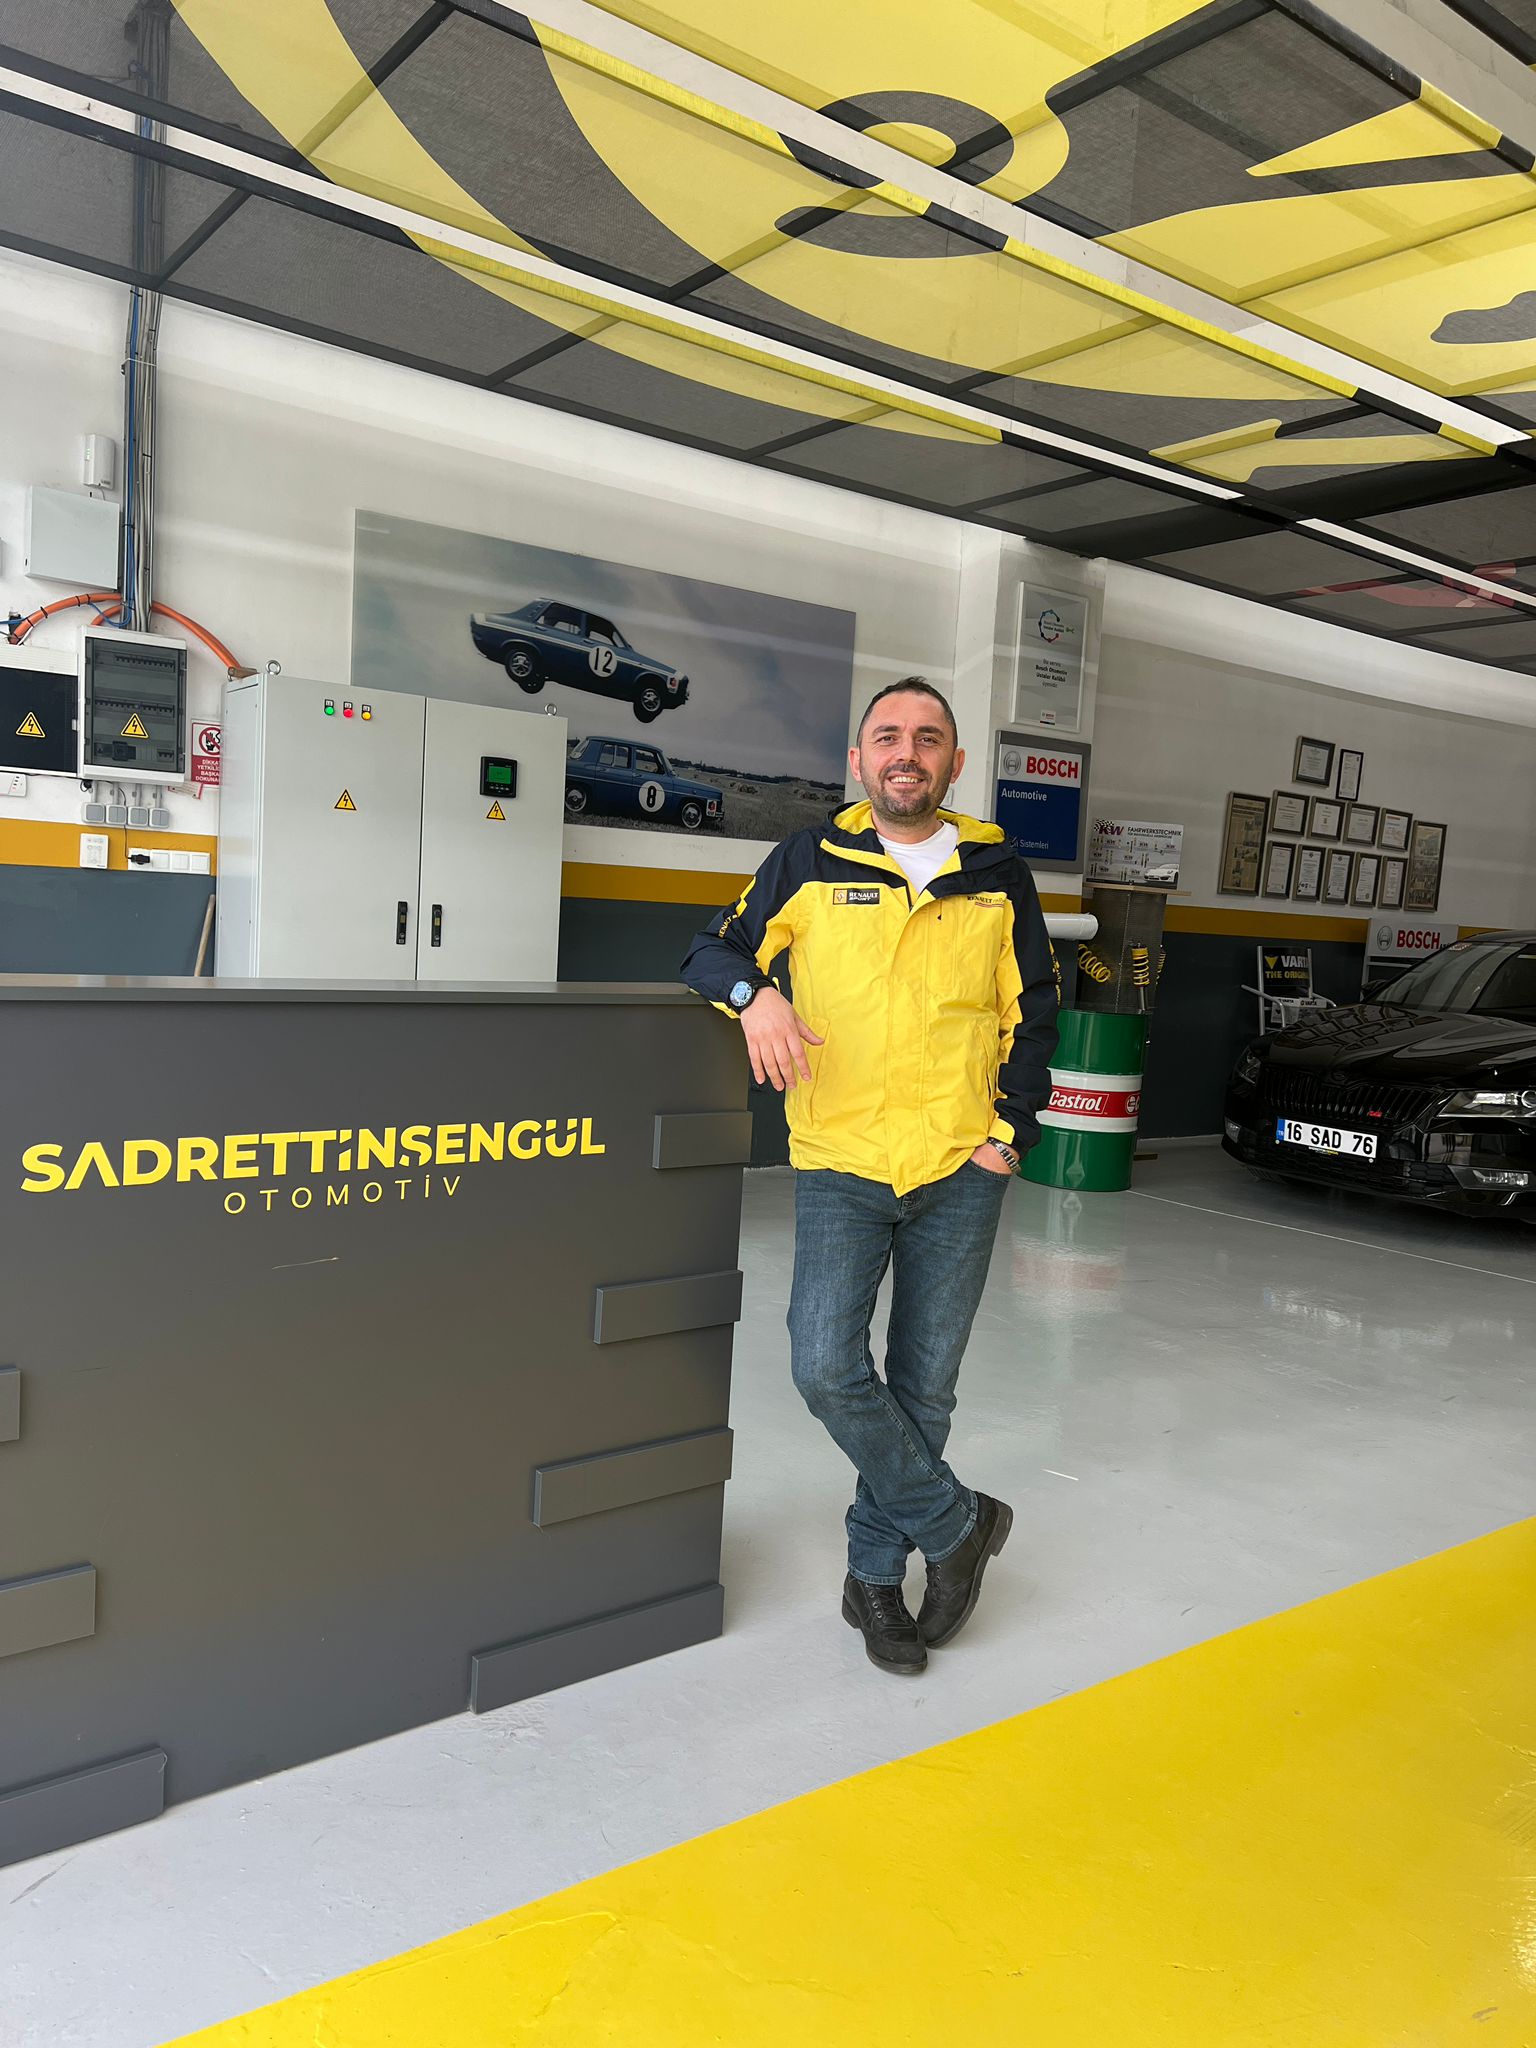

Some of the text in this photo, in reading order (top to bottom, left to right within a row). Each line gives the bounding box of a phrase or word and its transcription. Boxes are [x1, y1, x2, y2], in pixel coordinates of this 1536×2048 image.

[594, 648, 613, 673] 12
[1026, 756, 1079, 779] BOSCH
[646, 785, 657, 808] 8
[1001, 788, 1048, 801] Automotive
[1127, 826, 1182, 837] FAHRWERKSTECHNIK
[1020, 840, 1049, 850] Sistemleri
[1396, 929, 1441, 950] BOSCH
[1265, 970, 1283, 979] THE
[1048, 1090, 1103, 1111] Castrol
[1287, 1122, 1302, 1141] 16
[1310, 1127, 1341, 1149] SAD
[1352, 1134, 1373, 1155] 76
[223, 1174, 461, 1214] OTOMOTİV
